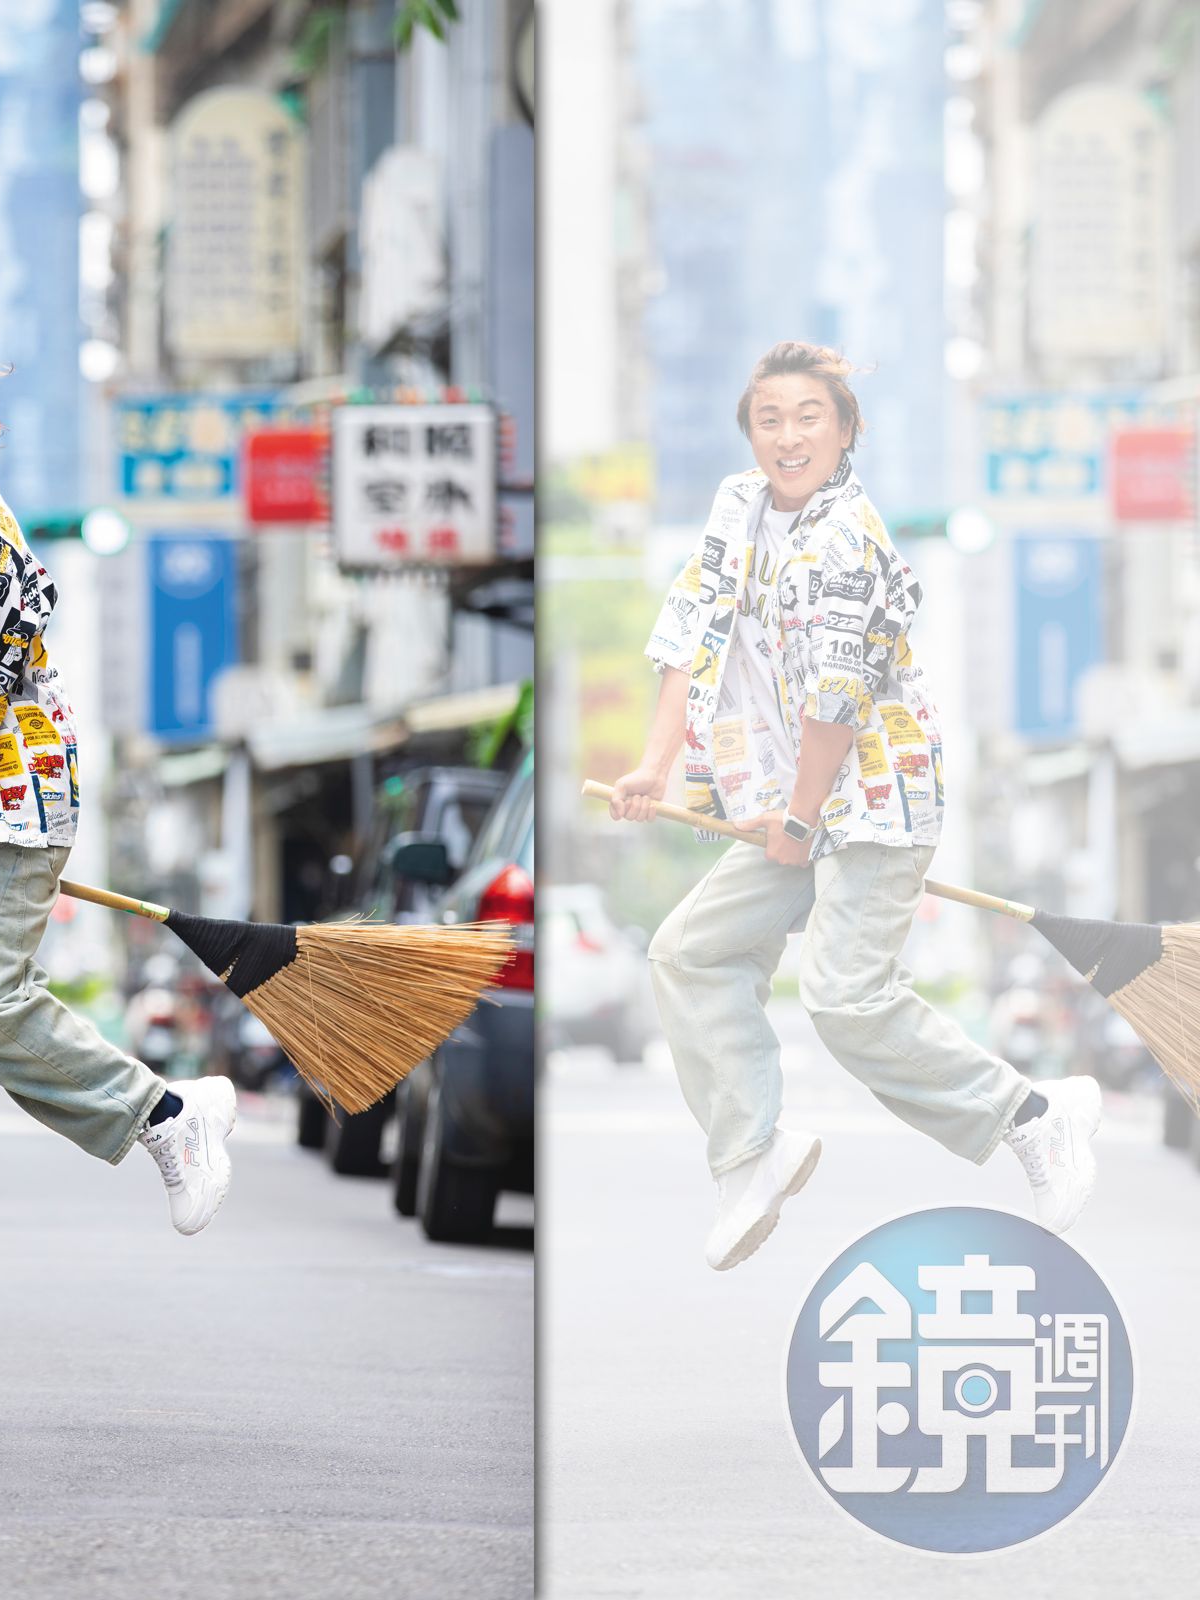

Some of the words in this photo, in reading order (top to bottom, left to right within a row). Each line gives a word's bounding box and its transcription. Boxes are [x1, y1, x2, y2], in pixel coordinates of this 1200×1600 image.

[830, 574, 867, 588] Dickies
[828, 614, 856, 628] 922
[829, 639, 861, 659] 100
[818, 676, 859, 698] 874
[146, 1134, 162, 1144] FILA
[184, 1117, 200, 1167] FILA
